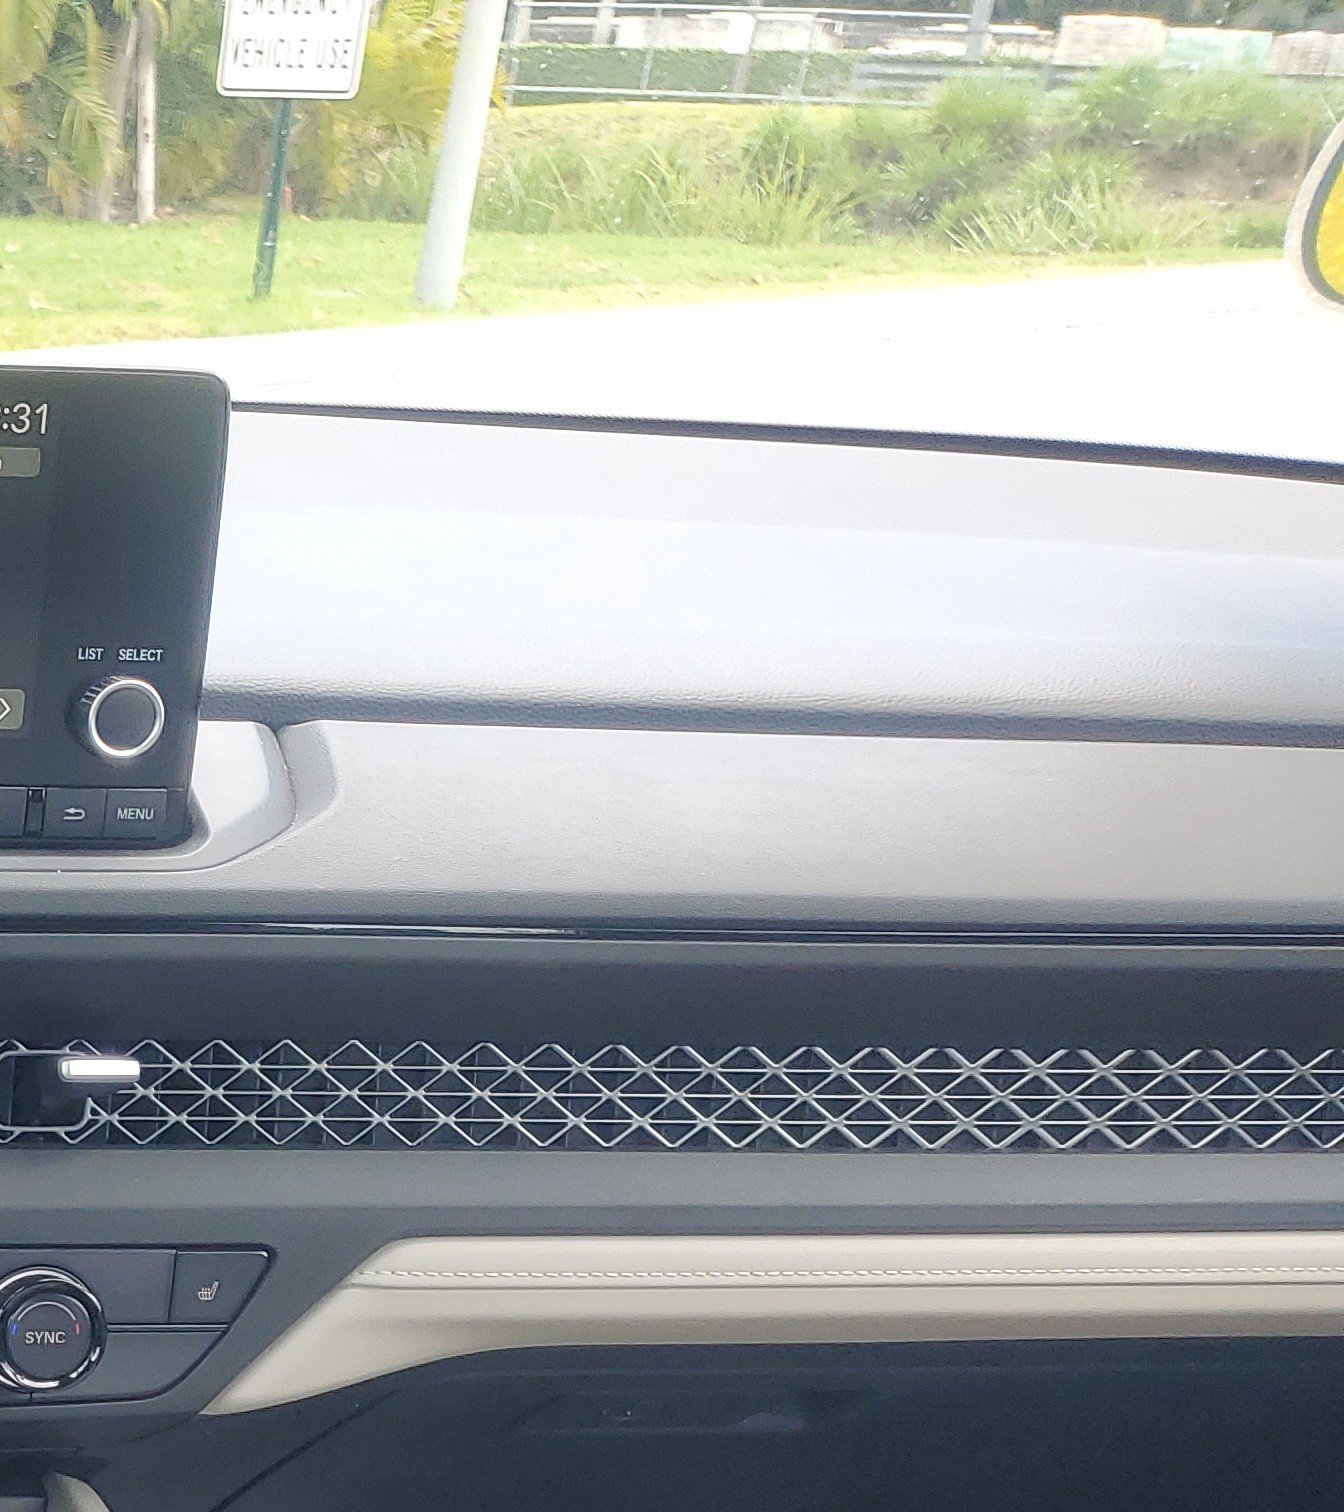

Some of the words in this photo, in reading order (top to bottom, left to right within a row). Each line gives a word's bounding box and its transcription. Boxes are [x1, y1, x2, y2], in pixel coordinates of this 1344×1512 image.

[77, 647, 104, 661] LIST
[118, 648, 164, 662] SELECT
[117, 807, 154, 821] MENU
[25, 1331, 66, 1345] SYNC
